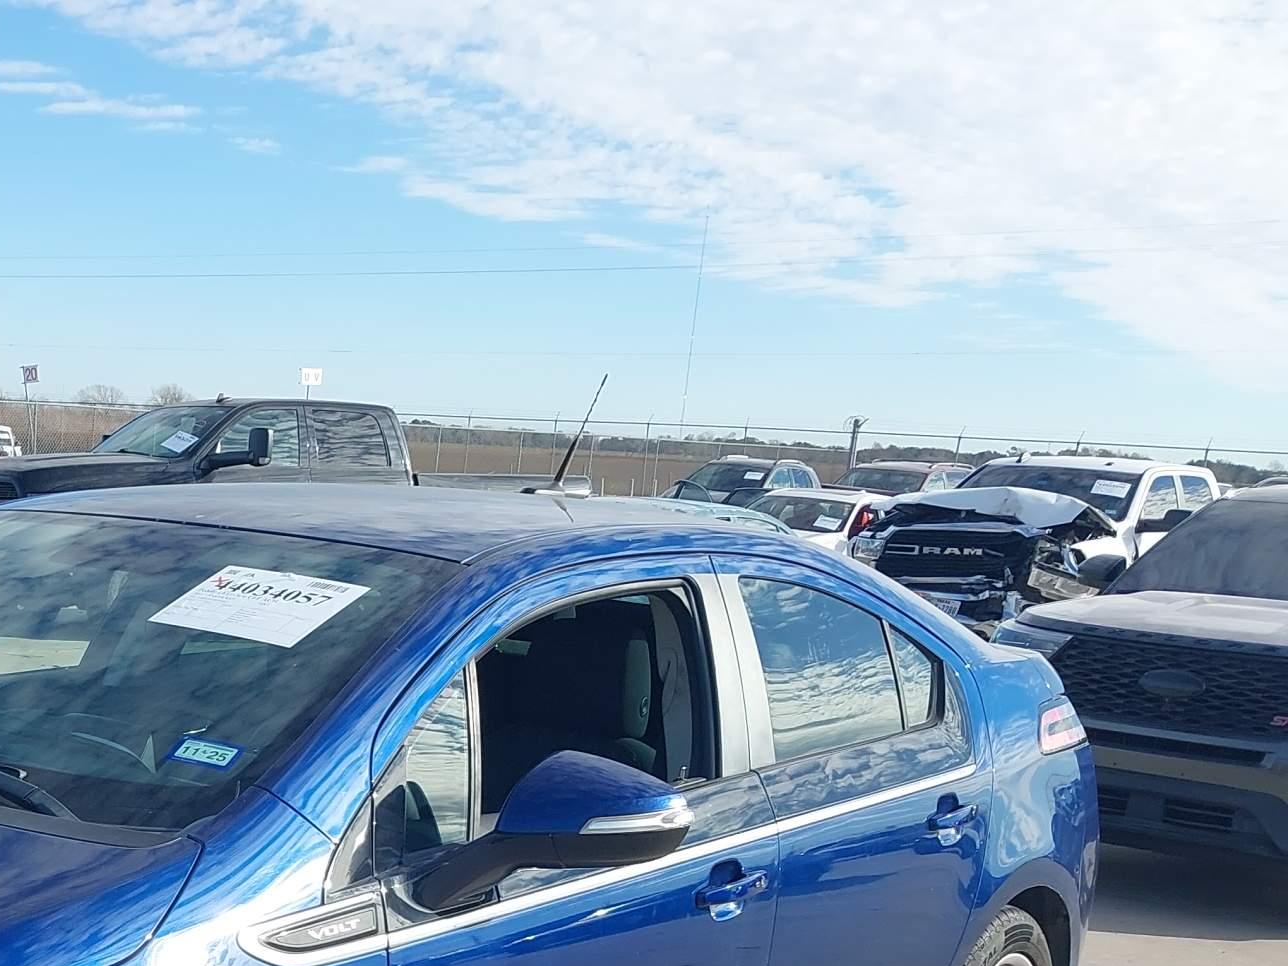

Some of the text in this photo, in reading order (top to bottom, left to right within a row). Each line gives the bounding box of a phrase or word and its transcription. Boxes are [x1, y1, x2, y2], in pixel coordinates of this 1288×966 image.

[24, 367, 38, 382] 20
[923, 546, 983, 556] RAM
[216, 579, 333, 607] 44034057
[205, 750, 230, 762] 25
[308, 918, 360, 940] VOLT
